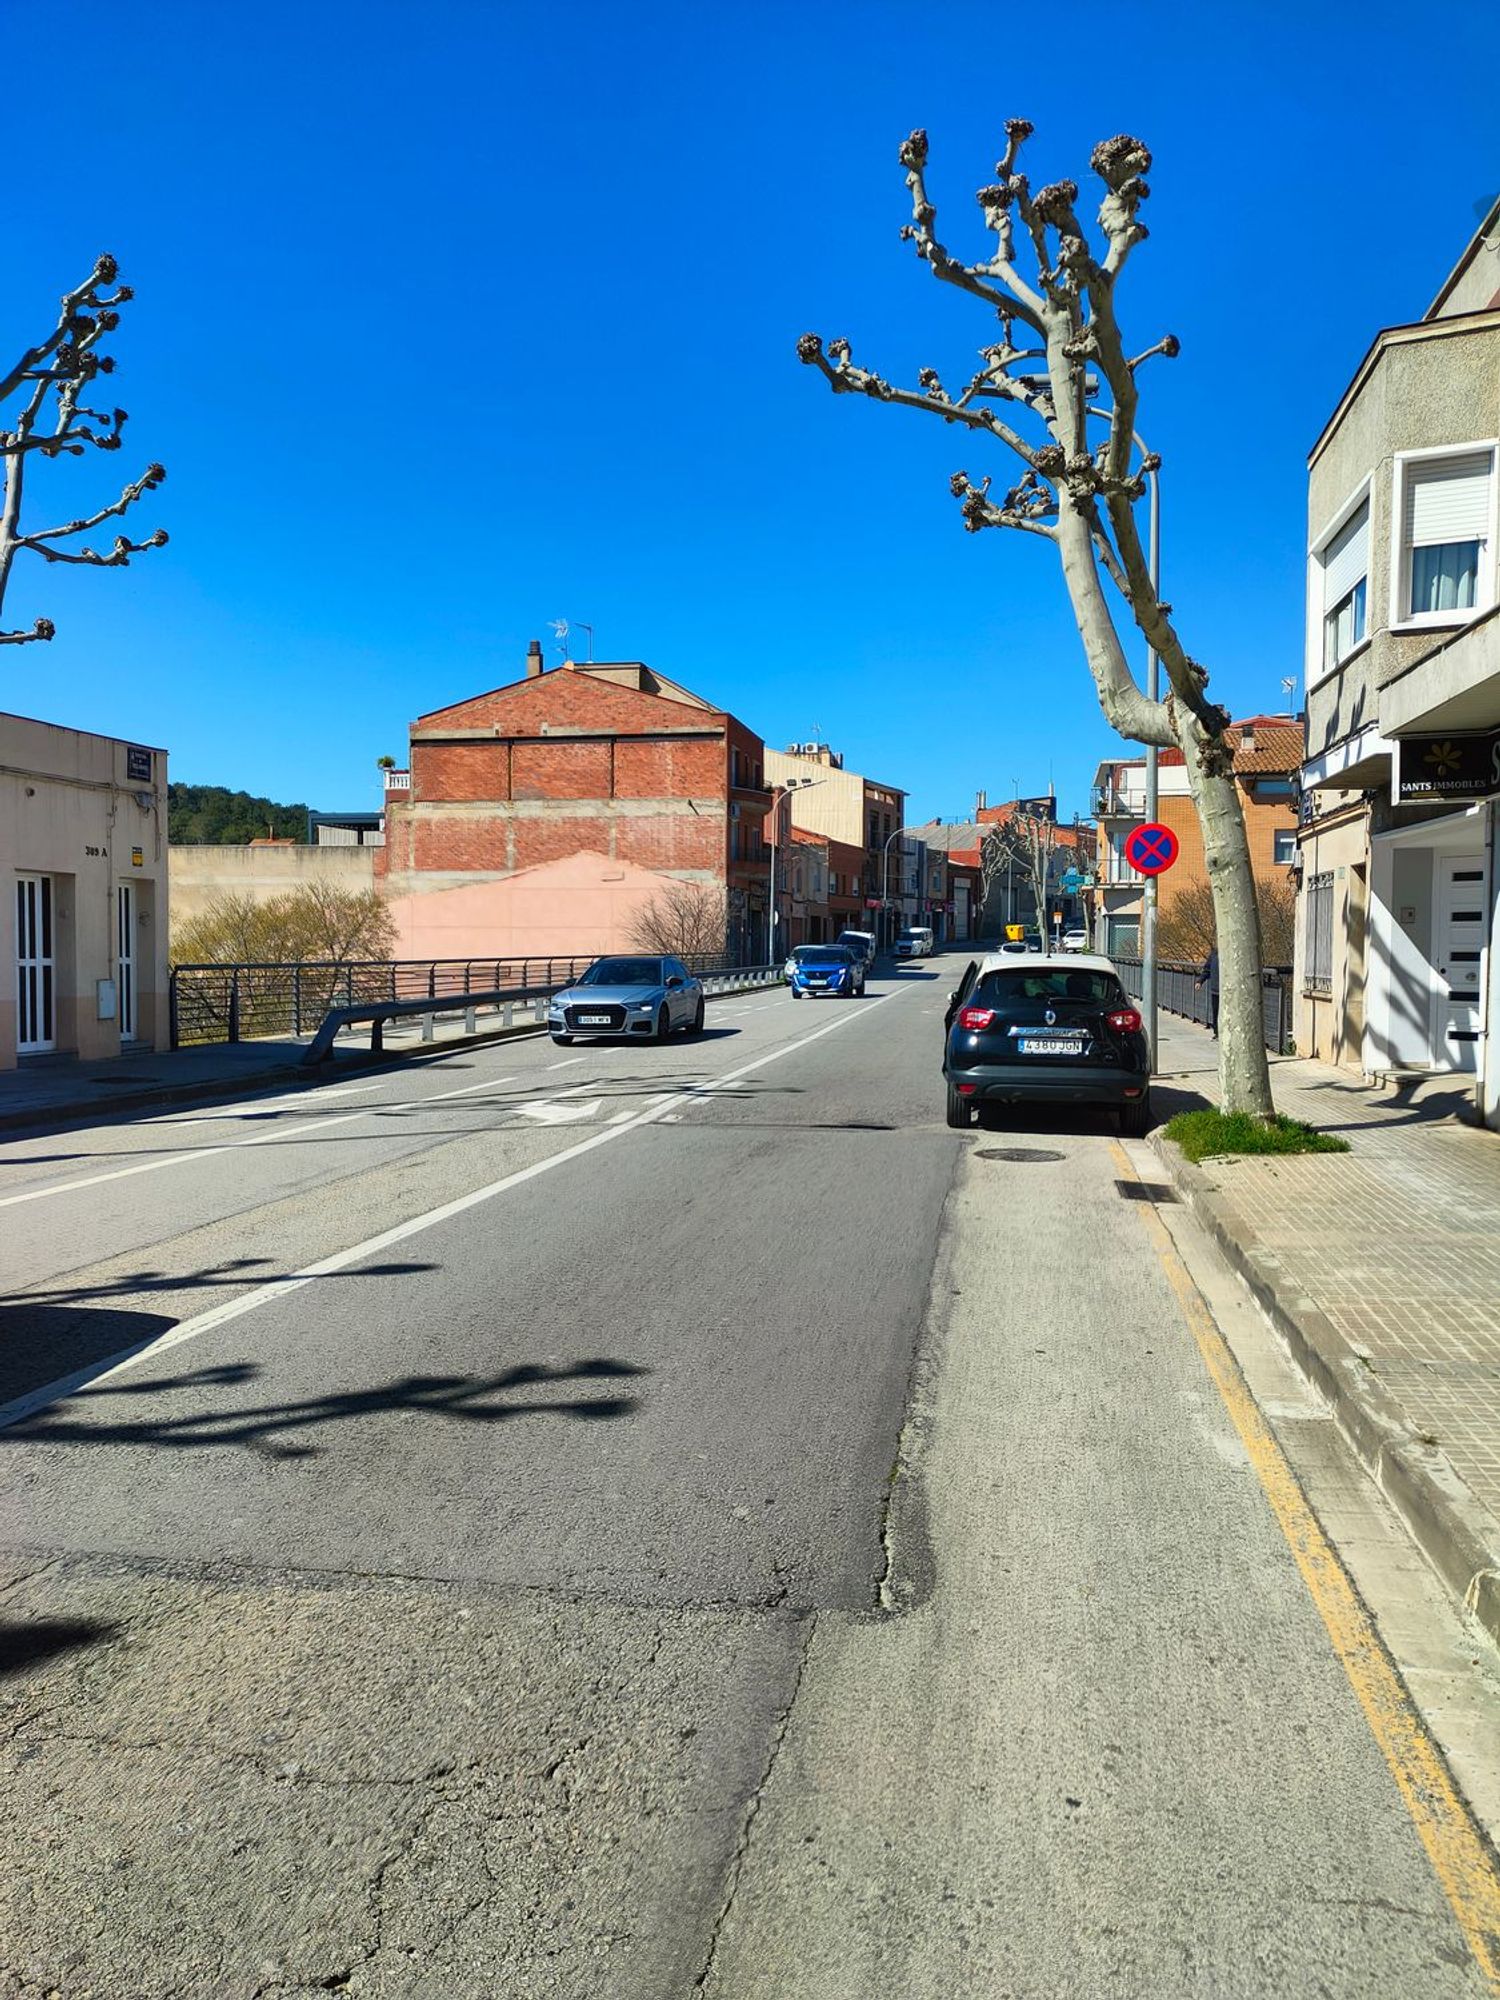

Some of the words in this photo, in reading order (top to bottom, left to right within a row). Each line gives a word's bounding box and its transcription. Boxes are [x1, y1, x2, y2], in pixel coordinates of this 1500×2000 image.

[1401, 782, 1431, 792] SANTS
[1026, 1039, 1056, 1050] 4380
[1059, 1039, 1080, 1051] JGN
